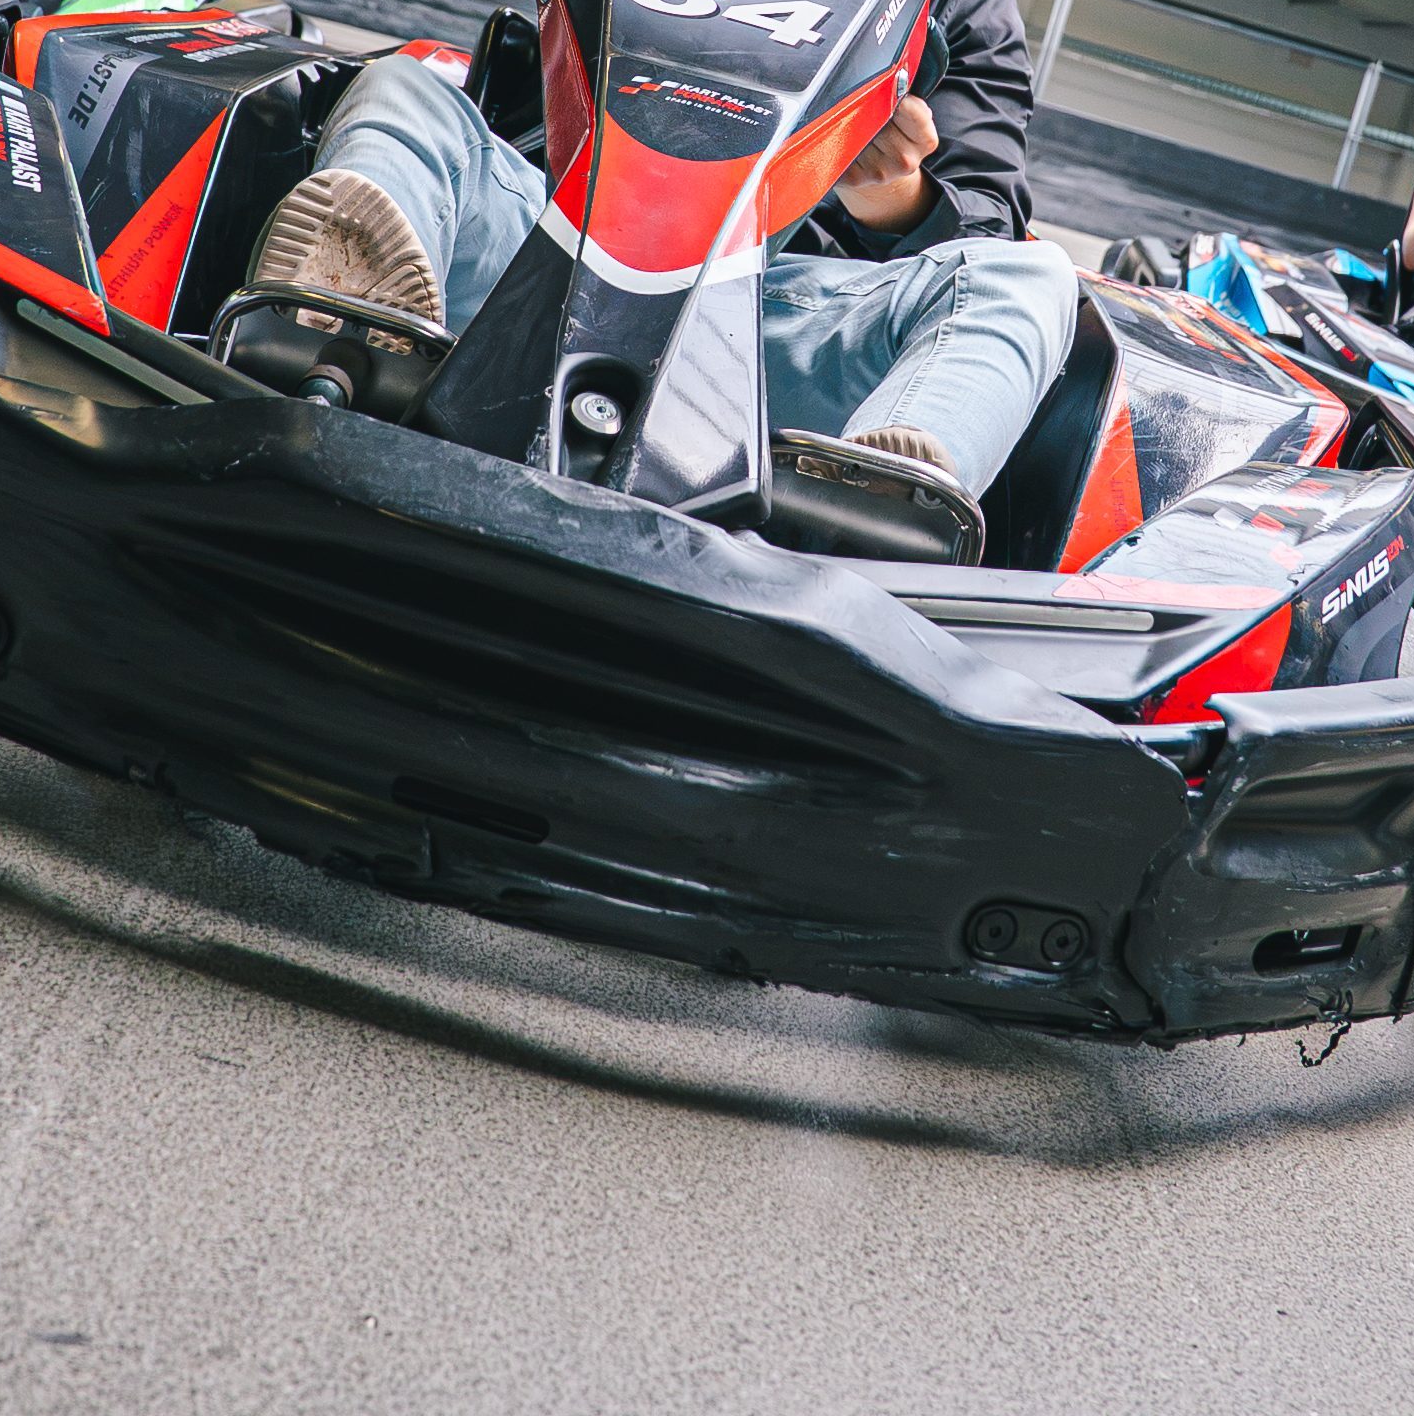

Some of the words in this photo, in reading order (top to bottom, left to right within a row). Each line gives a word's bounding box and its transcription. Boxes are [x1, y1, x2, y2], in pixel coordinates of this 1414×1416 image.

[679, 83, 721, 98] KART
[719, 94, 774, 117] PALAST
[3, 106, 36, 142] KART
[8, 136, 42, 193] PALAST
[106, 247, 149, 299] LITHIUM
[143, 202, 184, 249] POWER
